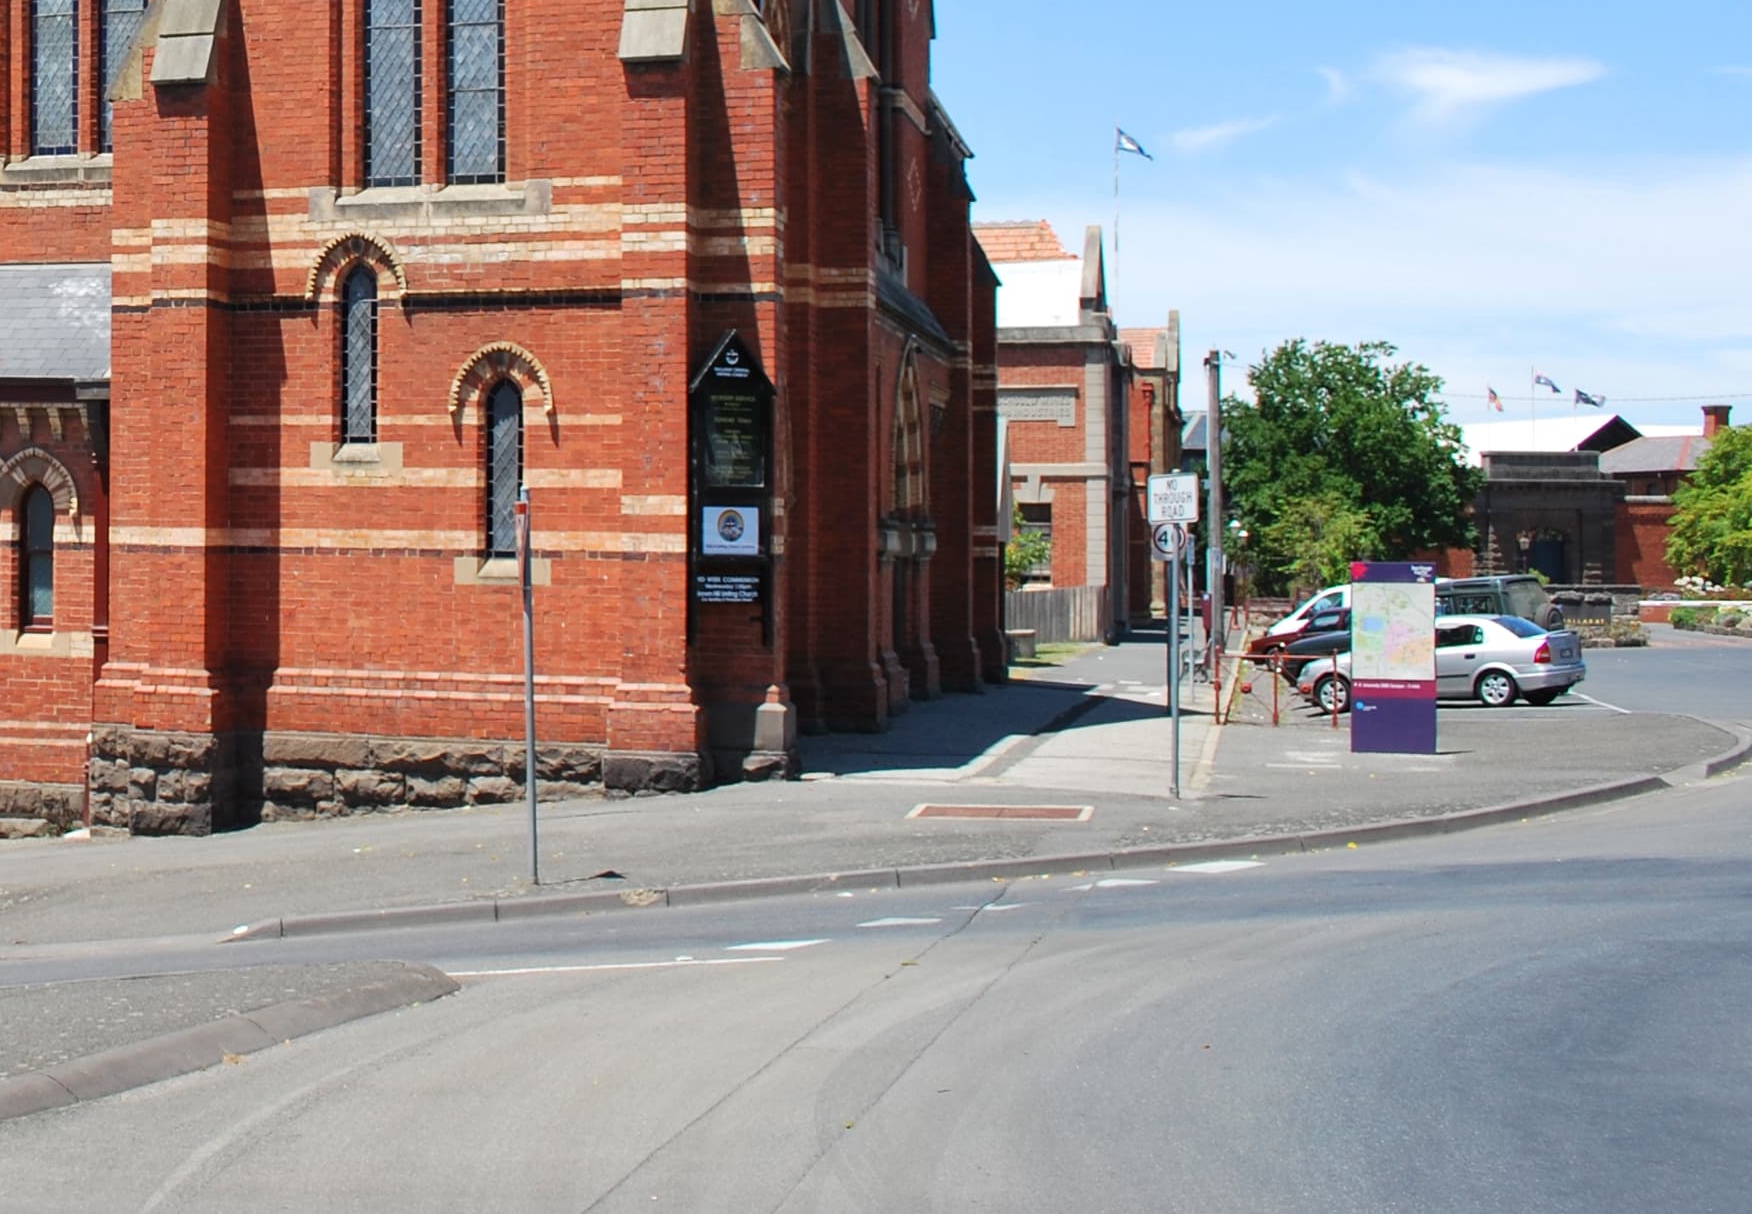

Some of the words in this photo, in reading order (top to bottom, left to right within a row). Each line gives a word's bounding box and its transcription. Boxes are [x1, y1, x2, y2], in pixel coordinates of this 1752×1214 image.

[1167, 479, 1178, 491] NO
[1154, 491, 1193, 505] THROUGH
[1161, 505, 1185, 518] ROAD
